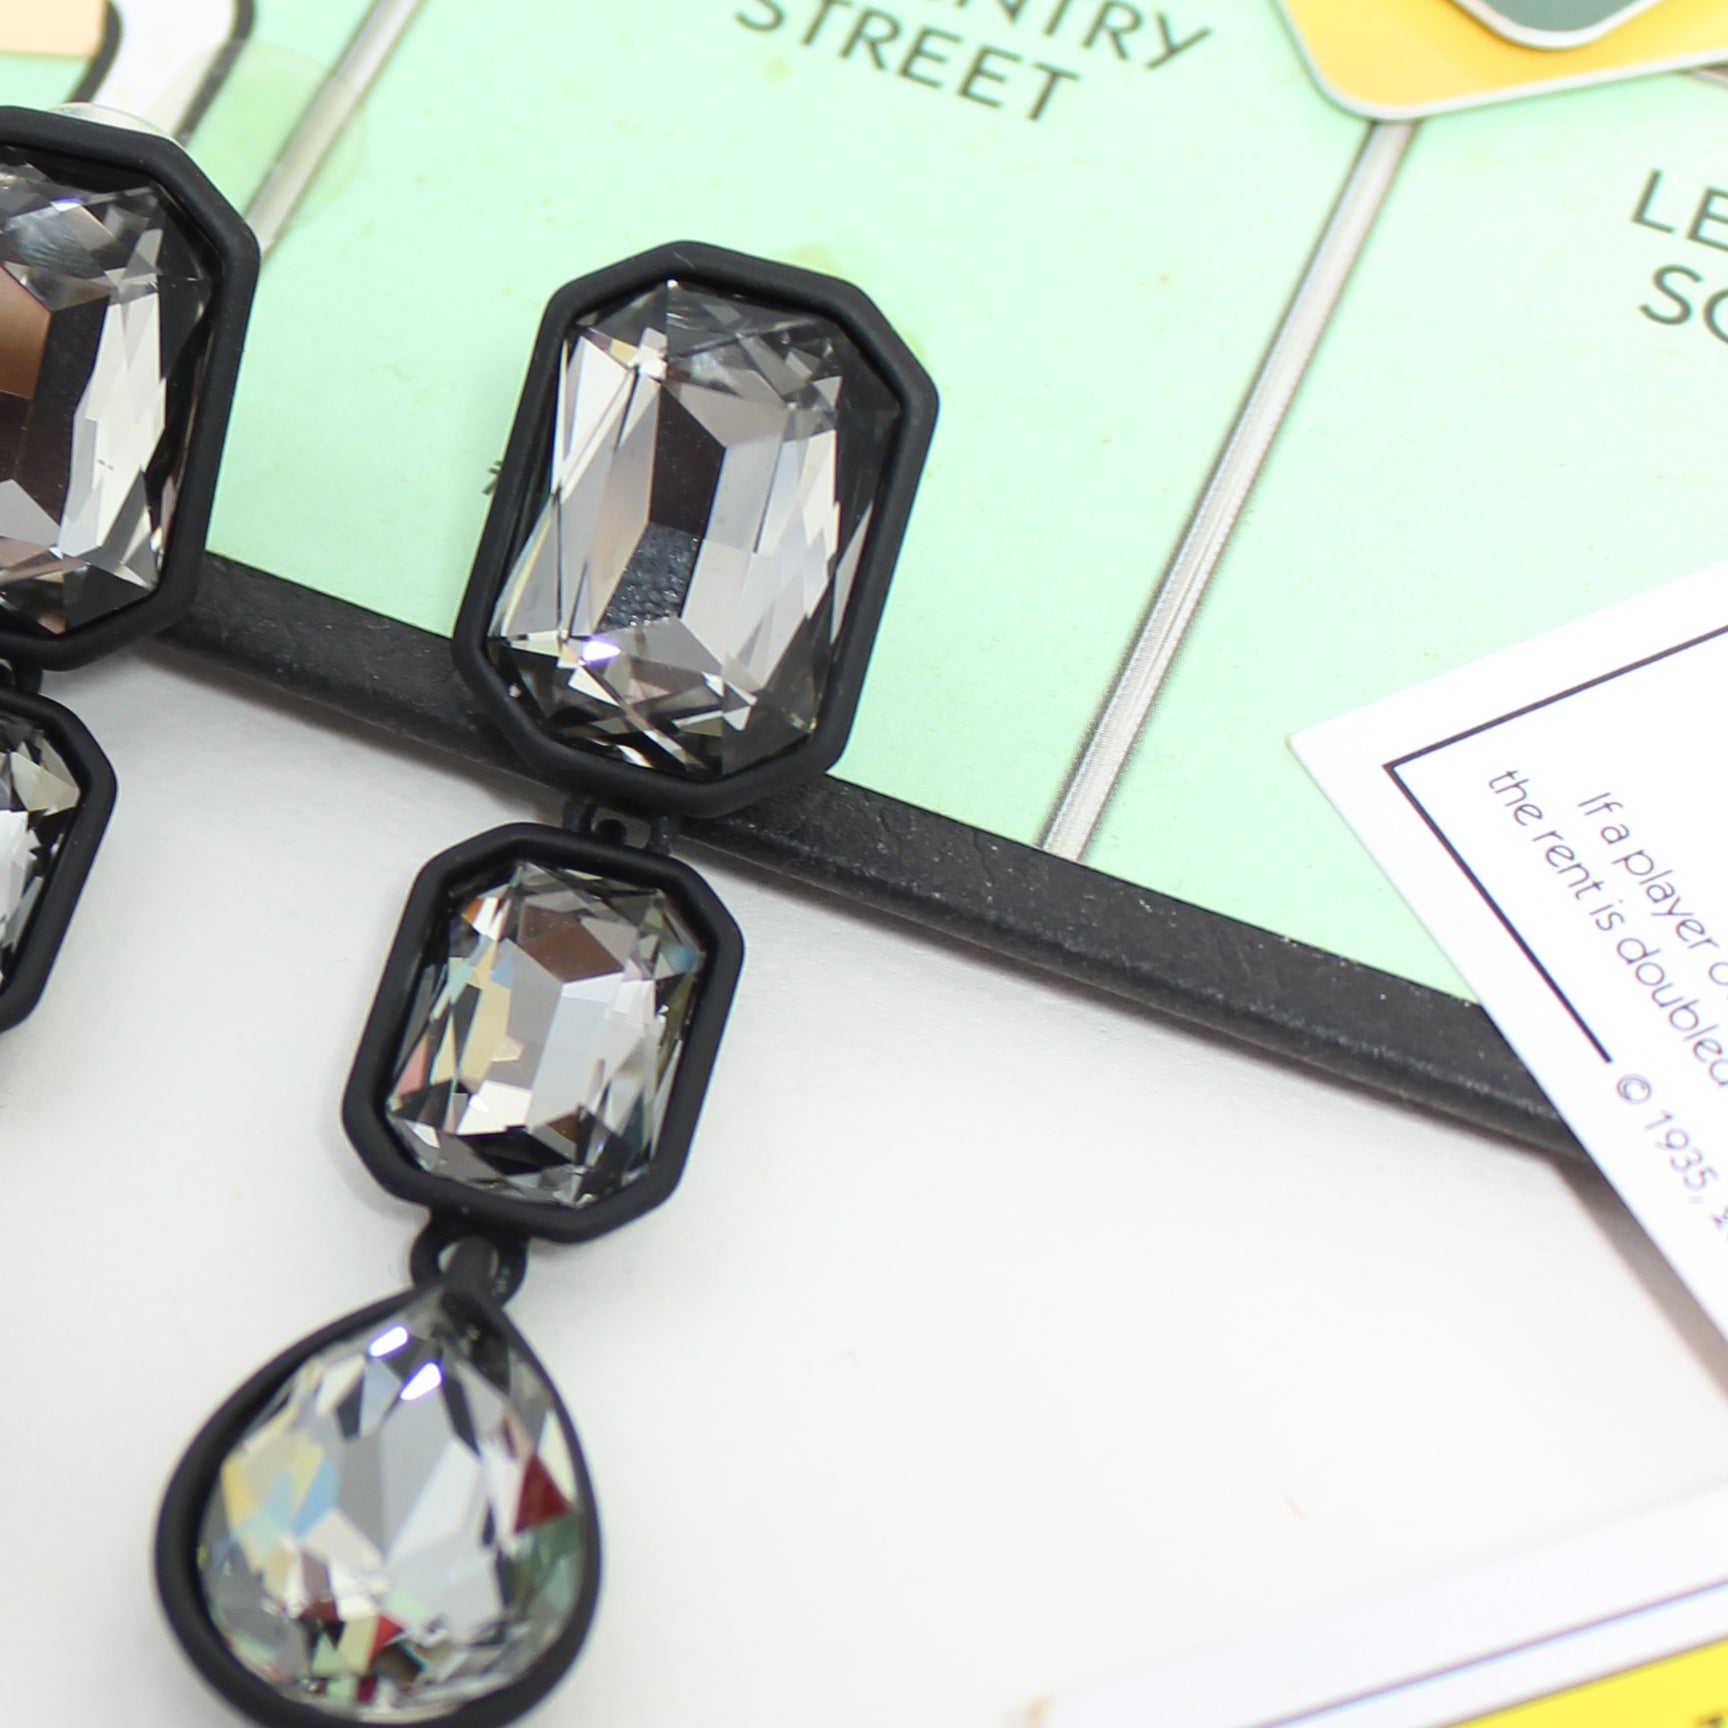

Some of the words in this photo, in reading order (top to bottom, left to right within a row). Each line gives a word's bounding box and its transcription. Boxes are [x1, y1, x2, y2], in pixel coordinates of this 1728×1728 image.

[1577, 791, 1624, 817] If
[1599, 822, 1631, 846] a
[1488, 768, 1544, 828] the
[1531, 828, 1606, 902] rent
[1588, 897, 1626, 932] is
[1611, 848, 1720, 951] player
